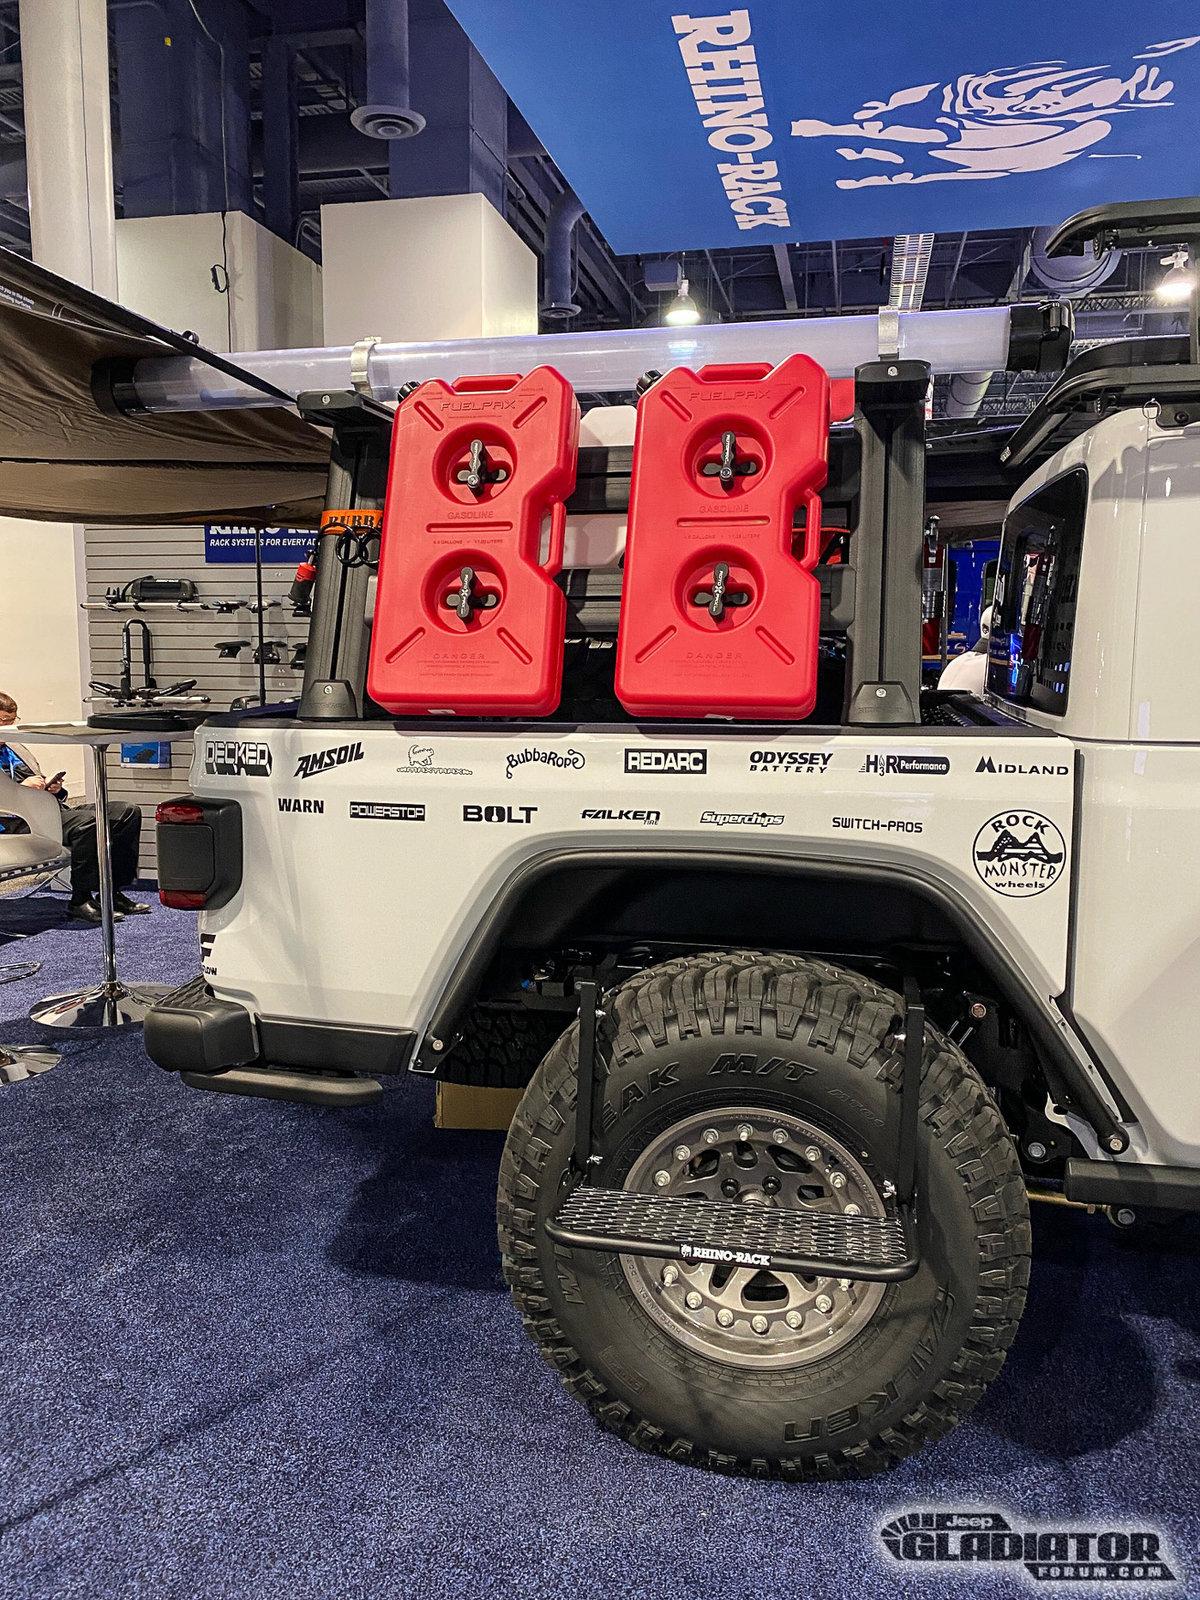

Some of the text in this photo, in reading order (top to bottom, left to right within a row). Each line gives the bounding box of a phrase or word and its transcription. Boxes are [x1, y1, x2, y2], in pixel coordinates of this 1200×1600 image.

[671, 9, 791, 230] RHINO-RACK
[689, 389, 770, 401] FUELPAX
[440, 399, 516, 412] FUELPAX
[447, 510, 494, 520] GASOLINE
[699, 504, 750, 513] GASOLINE
[210, 538, 230, 547] RACK
[231, 538, 264, 547] SYSTES
[265, 538, 281, 546] FOR
[282, 538, 306, 546] EVERY
[205, 740, 272, 777] DECKED
[294, 741, 364, 779] AMSOIL
[627, 751, 704, 772] REDARC
[749, 751, 833, 766] ODYSSEY
[900, 760, 948, 772] Performance
[975, 756, 1069, 776] MIDLAND
[750, 765, 828, 774] BATTERY
[278, 798, 324, 814] WARN
[350, 803, 425, 820] POWERSTOP
[463, 805, 538, 824] BOLT
[580, 809, 661, 821] FALKEN
[700, 811, 785, 827] Superchips
[832, 816, 923, 834] SWITCH-PROS
[991, 814, 1051, 835] ROCK
[984, 861, 1057, 880] MONSTER
[995, 880, 1046, 889] wheels
[707, 1053, 818, 1081] M/T
[692, 1246, 771, 1267] RHINO-RACK
